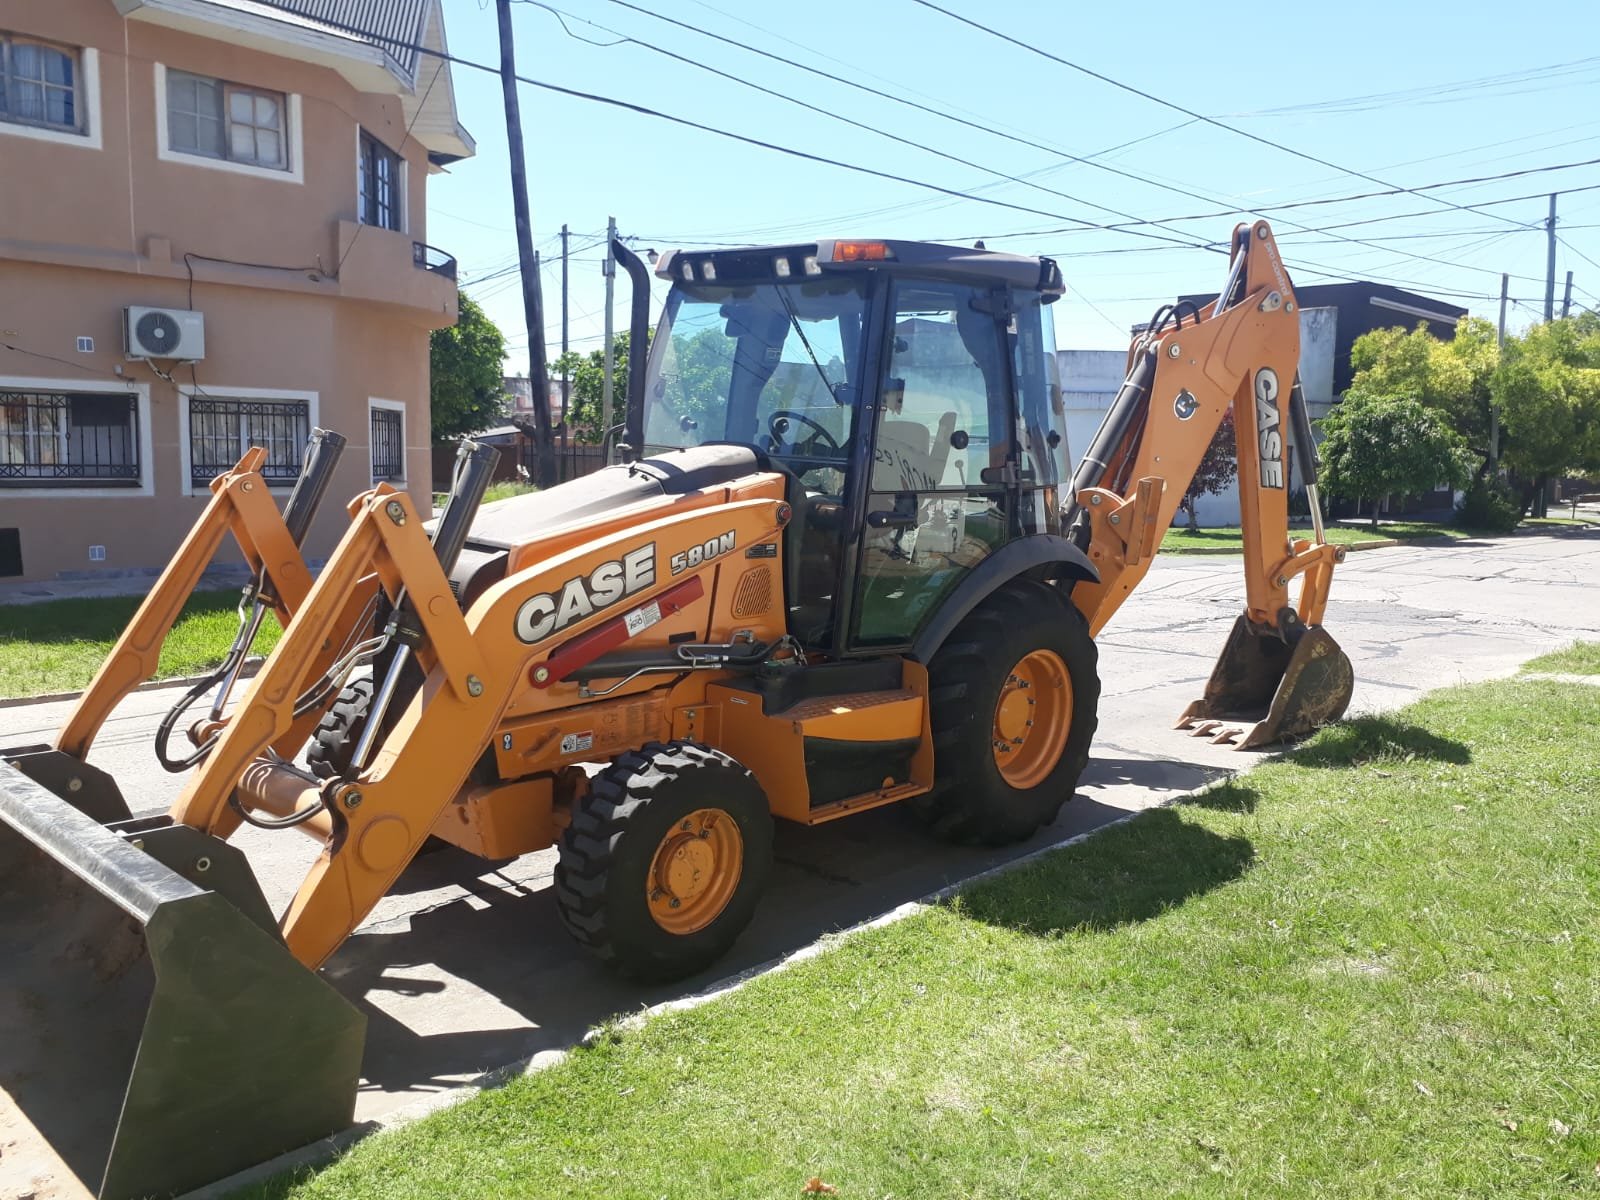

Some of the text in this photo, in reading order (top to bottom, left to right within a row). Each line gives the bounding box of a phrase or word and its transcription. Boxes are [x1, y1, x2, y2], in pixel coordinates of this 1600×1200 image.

[1272, 260, 1290, 296] control
[1255, 367, 1283, 489] CASE
[514, 542, 656, 644] CASE
[671, 530, 736, 576] 580N
